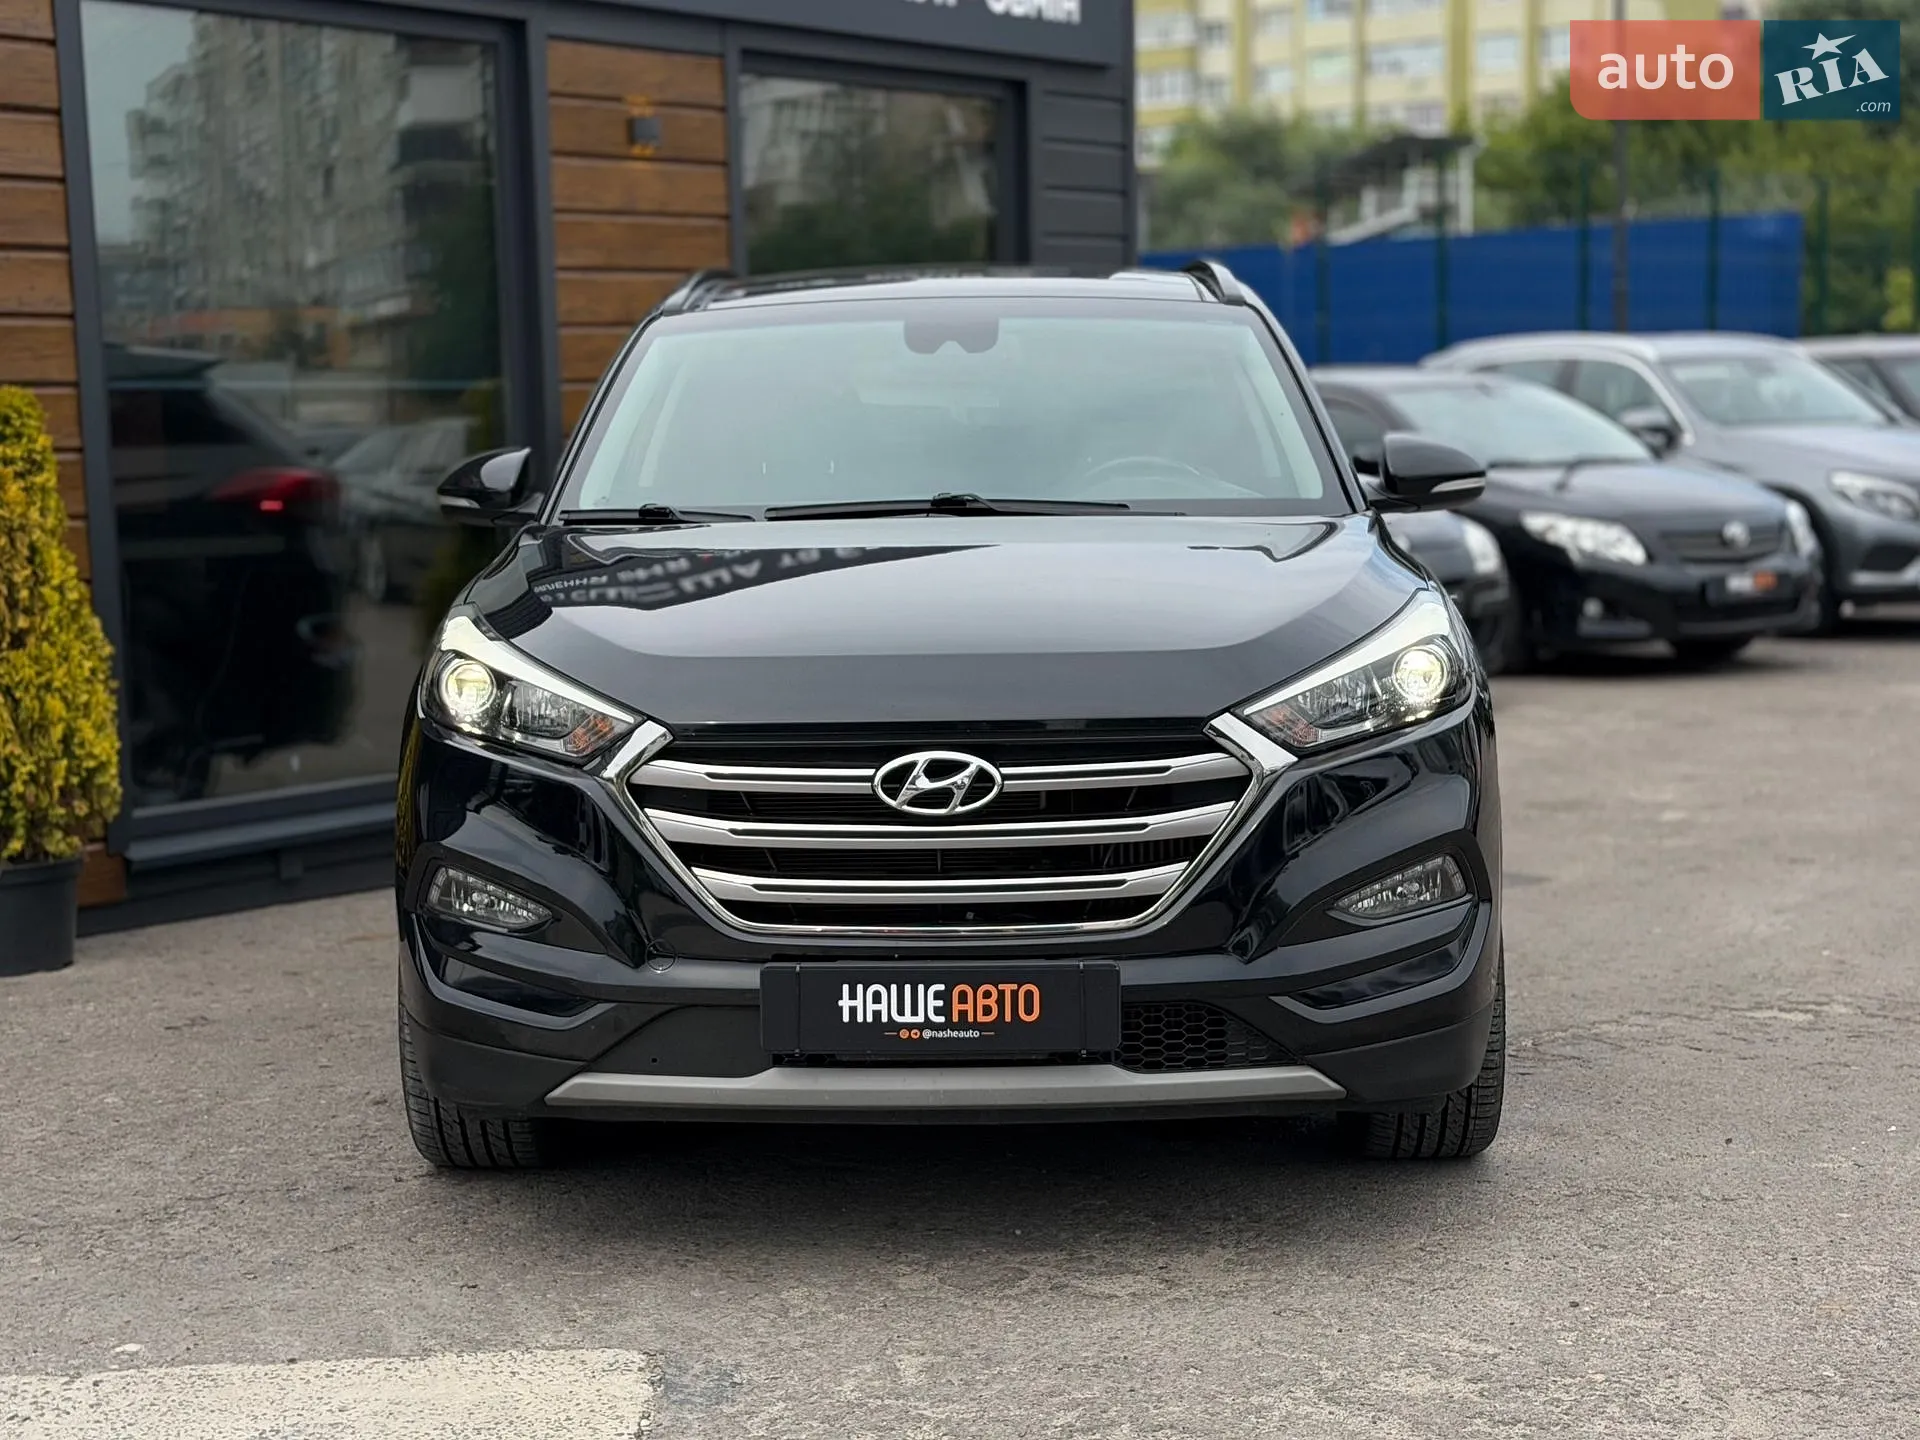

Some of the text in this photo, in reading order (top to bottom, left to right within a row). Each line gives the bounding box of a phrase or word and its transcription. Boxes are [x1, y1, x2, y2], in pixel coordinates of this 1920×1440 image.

[837, 983, 1041, 1023] НАШЕ АВТО
[922, 1028, 980, 1039] @nasheauto
